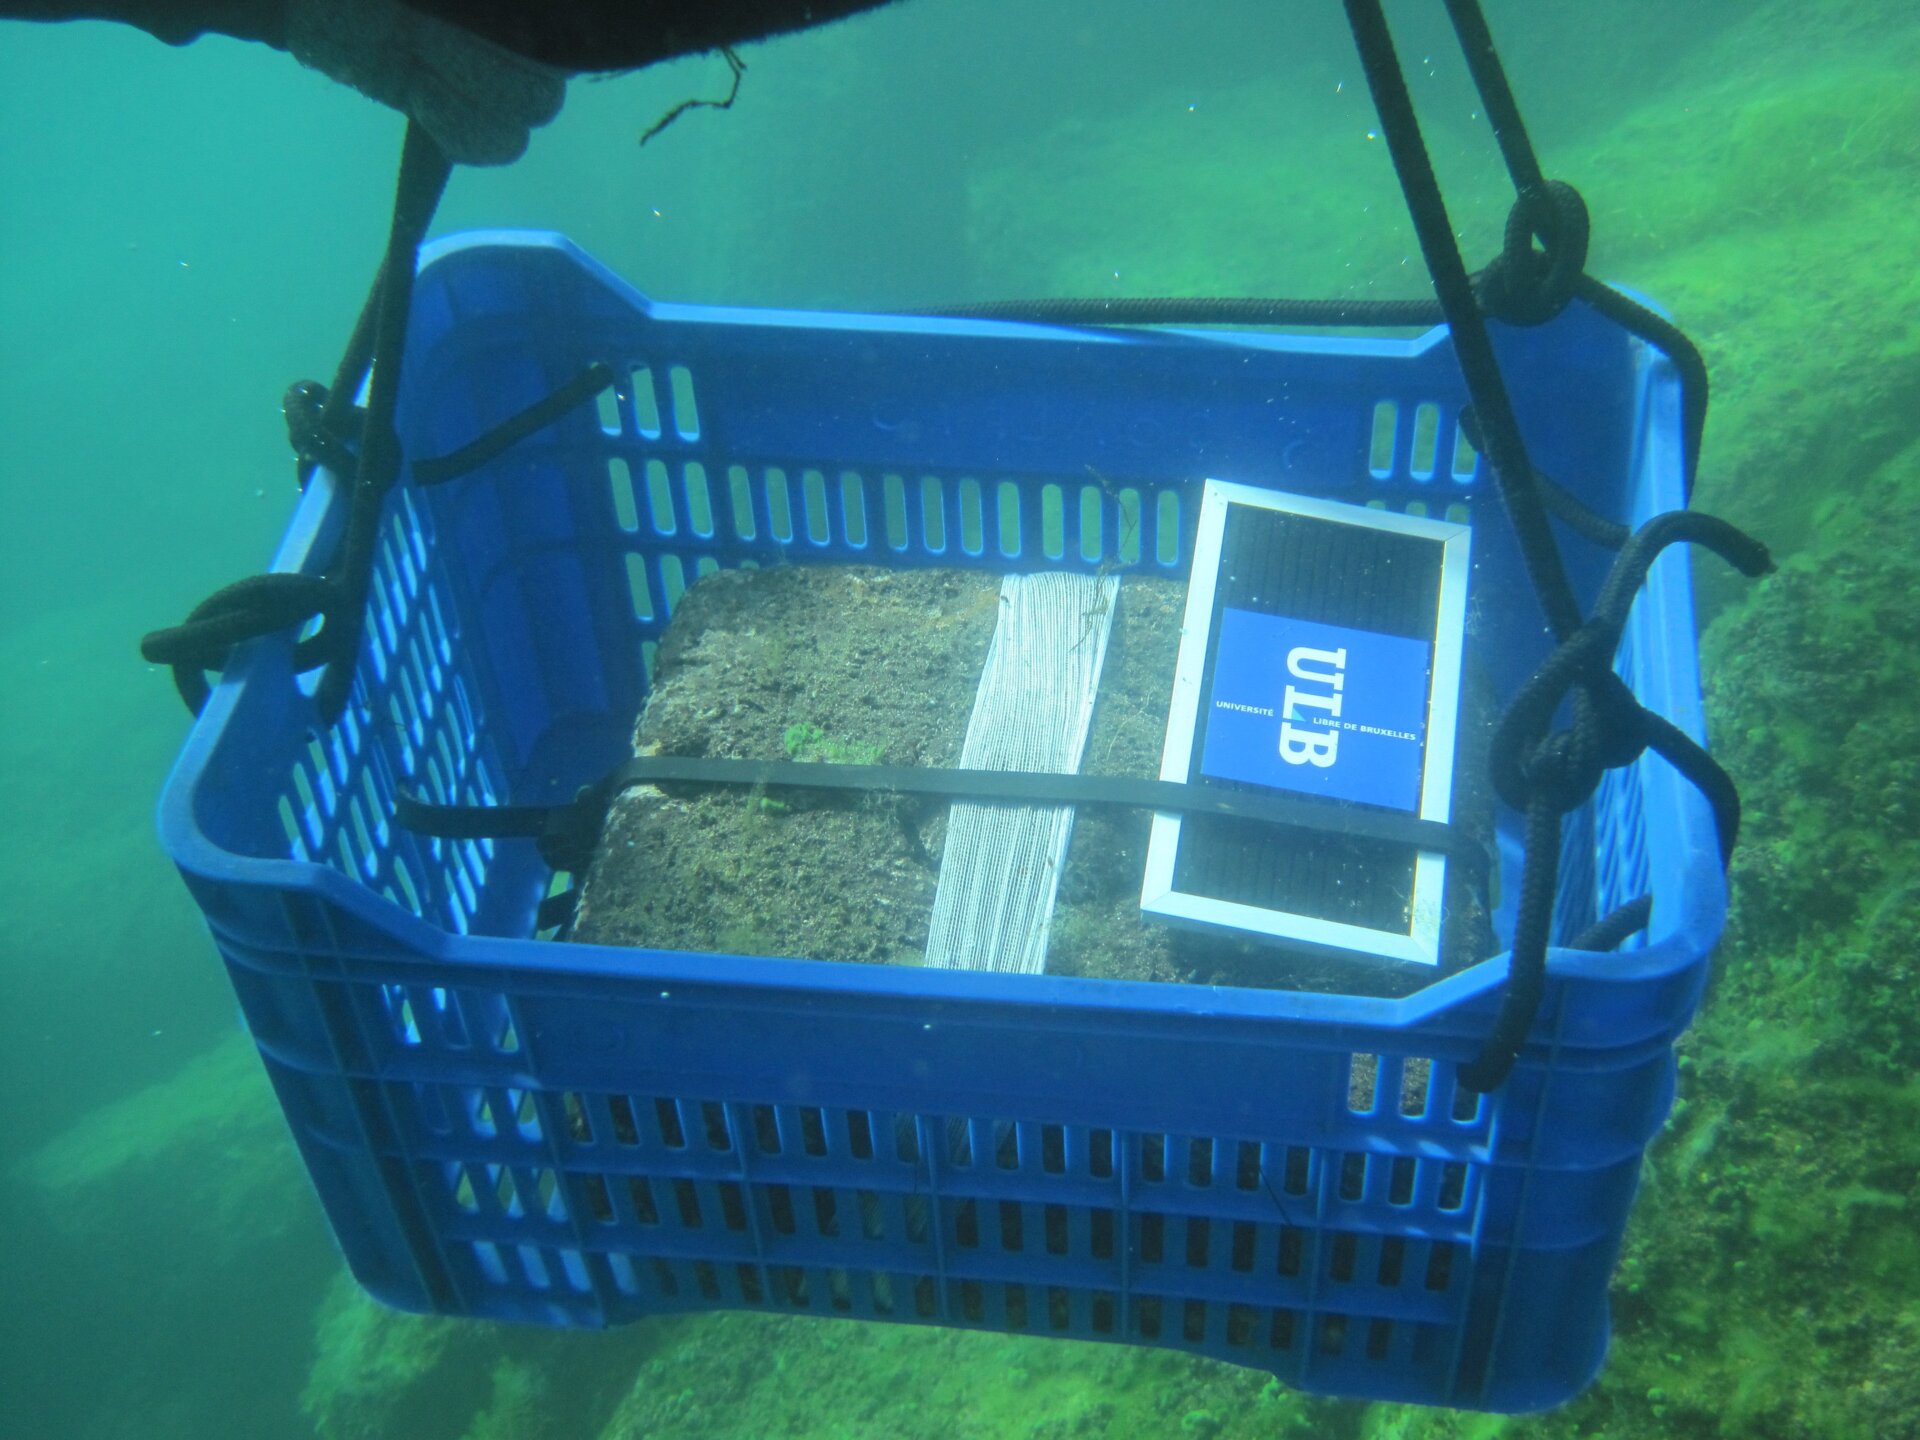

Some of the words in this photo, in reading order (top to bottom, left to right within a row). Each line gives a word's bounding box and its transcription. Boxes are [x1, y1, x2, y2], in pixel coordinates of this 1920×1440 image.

[1216, 700, 1274, 717] UNIVERSITÉ
[1313, 717, 1341, 729] LIBRE
[1344, 722, 1358, 731] DE
[1360, 724, 1417, 741] BRUXELLES
[1279, 646, 1346, 768] ULB
